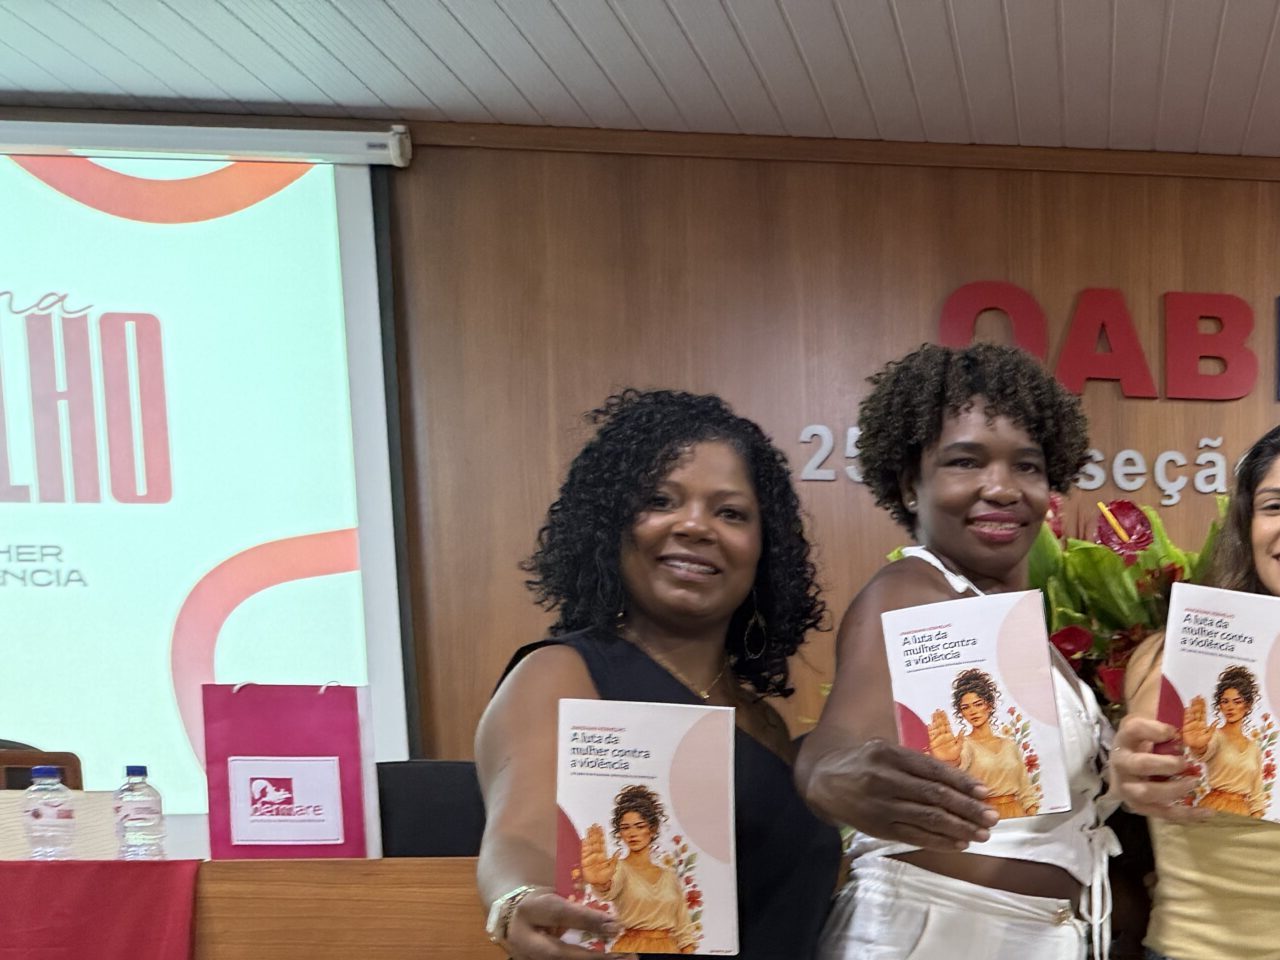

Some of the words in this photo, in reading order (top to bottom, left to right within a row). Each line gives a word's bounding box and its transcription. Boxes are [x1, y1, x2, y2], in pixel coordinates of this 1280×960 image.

[0, 569, 88, 587] NCIA
[1183, 614, 1191, 624] A
[1194, 615, 1213, 627] luta
[1215, 618, 1229, 629] da
[902, 637, 911, 646] A
[912, 633, 933, 645] luta
[934, 630, 948, 640] da
[1181, 626, 1218, 638] mulher
[1220, 632, 1254, 645] contra
[903, 643, 940, 656] mulher
[943, 638, 977, 650] contra
[1180, 637, 1187, 645] a
[1189, 637, 1235, 652] violência
[913, 650, 961, 665] violência
[570, 732, 579, 743] A
[581, 732, 603, 744] luta
[604, 733, 619, 745] da
[570, 746, 608, 757] mulher
[611, 748, 650, 759] contra
[570, 759, 577, 768] a
[579, 758, 630, 770] violência
